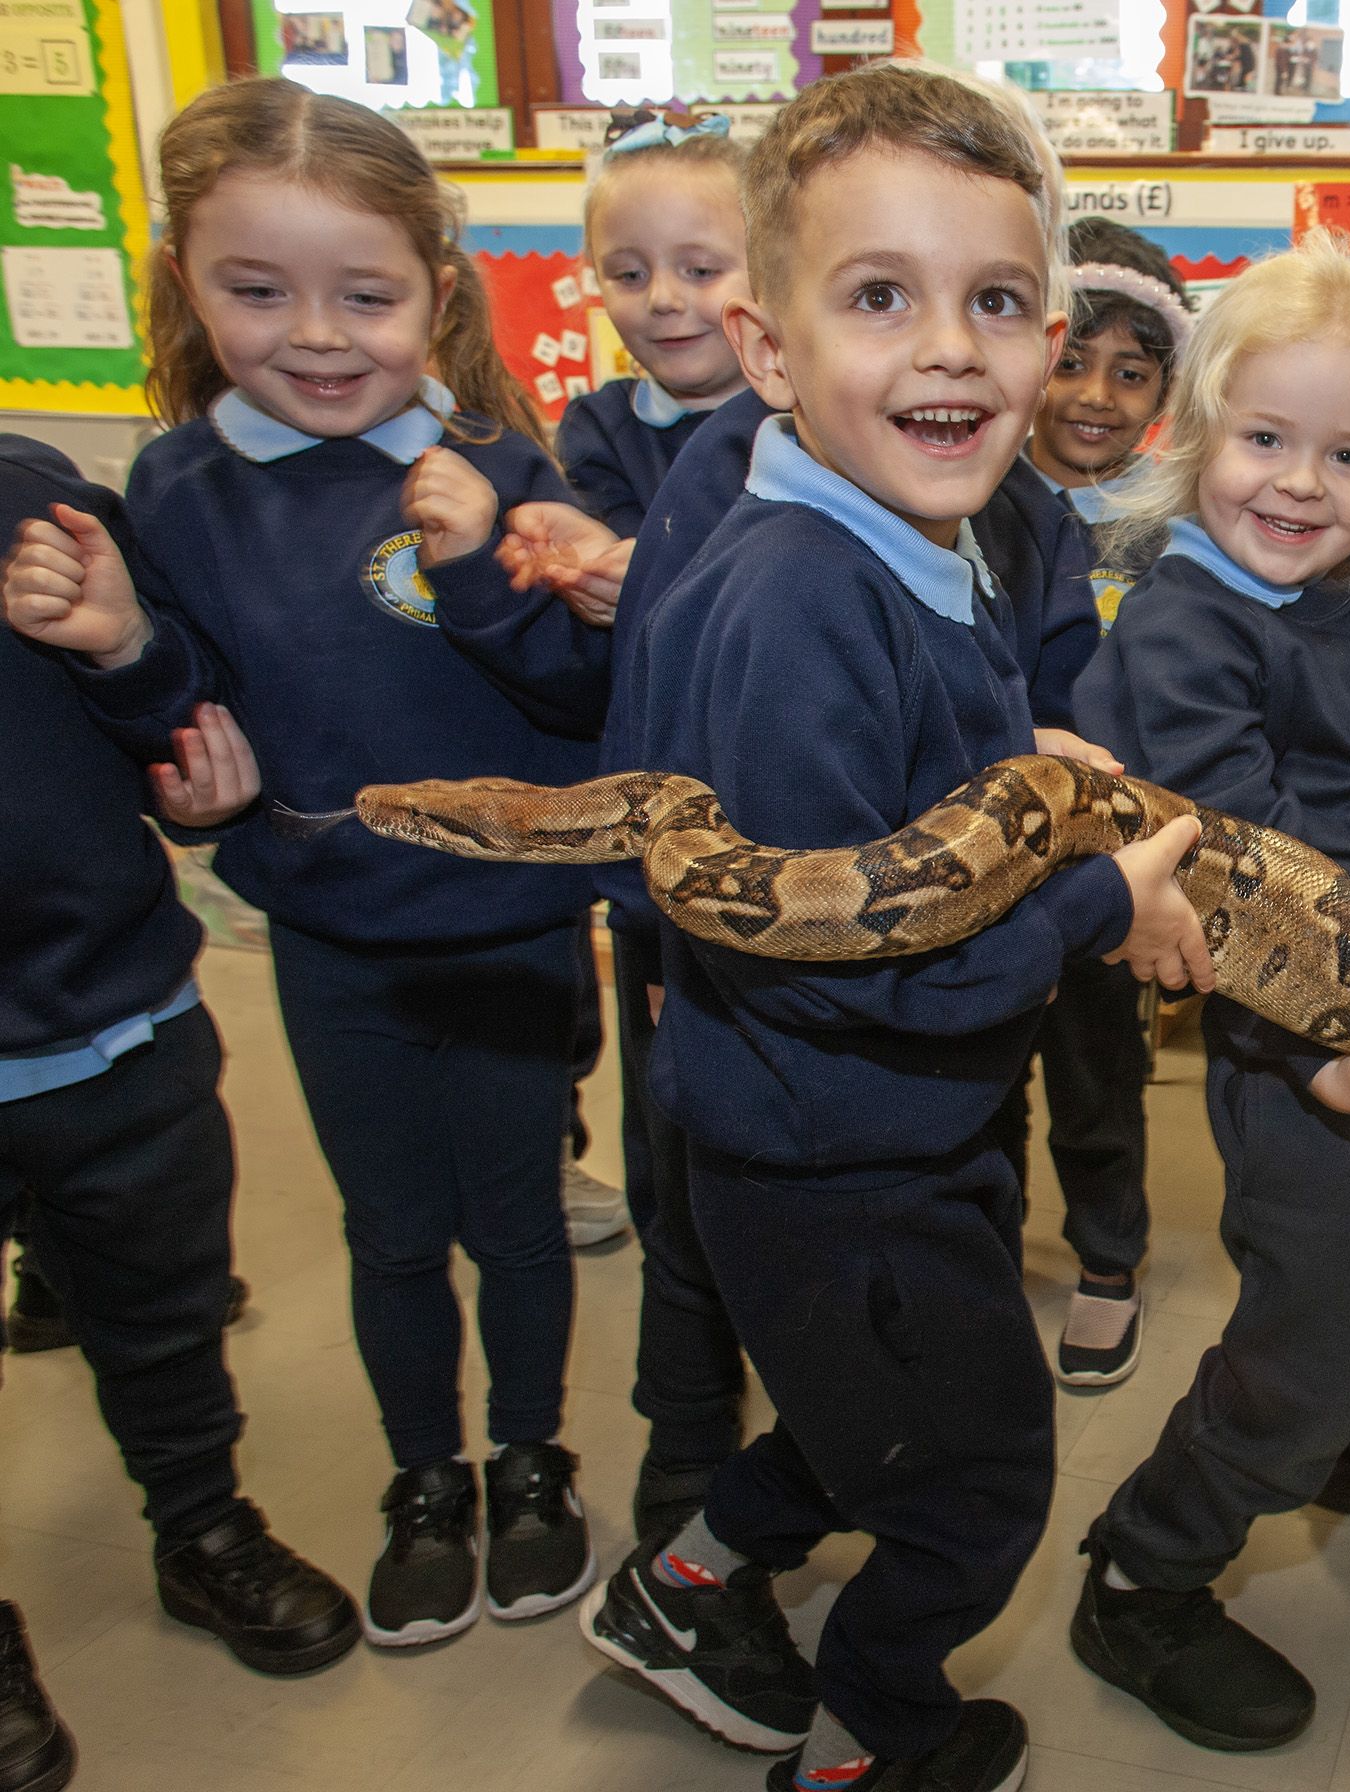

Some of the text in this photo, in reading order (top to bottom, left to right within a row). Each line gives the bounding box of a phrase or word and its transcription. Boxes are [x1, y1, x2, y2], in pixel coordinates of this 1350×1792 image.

[1254, 130, 1297, 154] give
[1065, 182, 1173, 217] unds (£)
[379, 530, 423, 559] THERE
